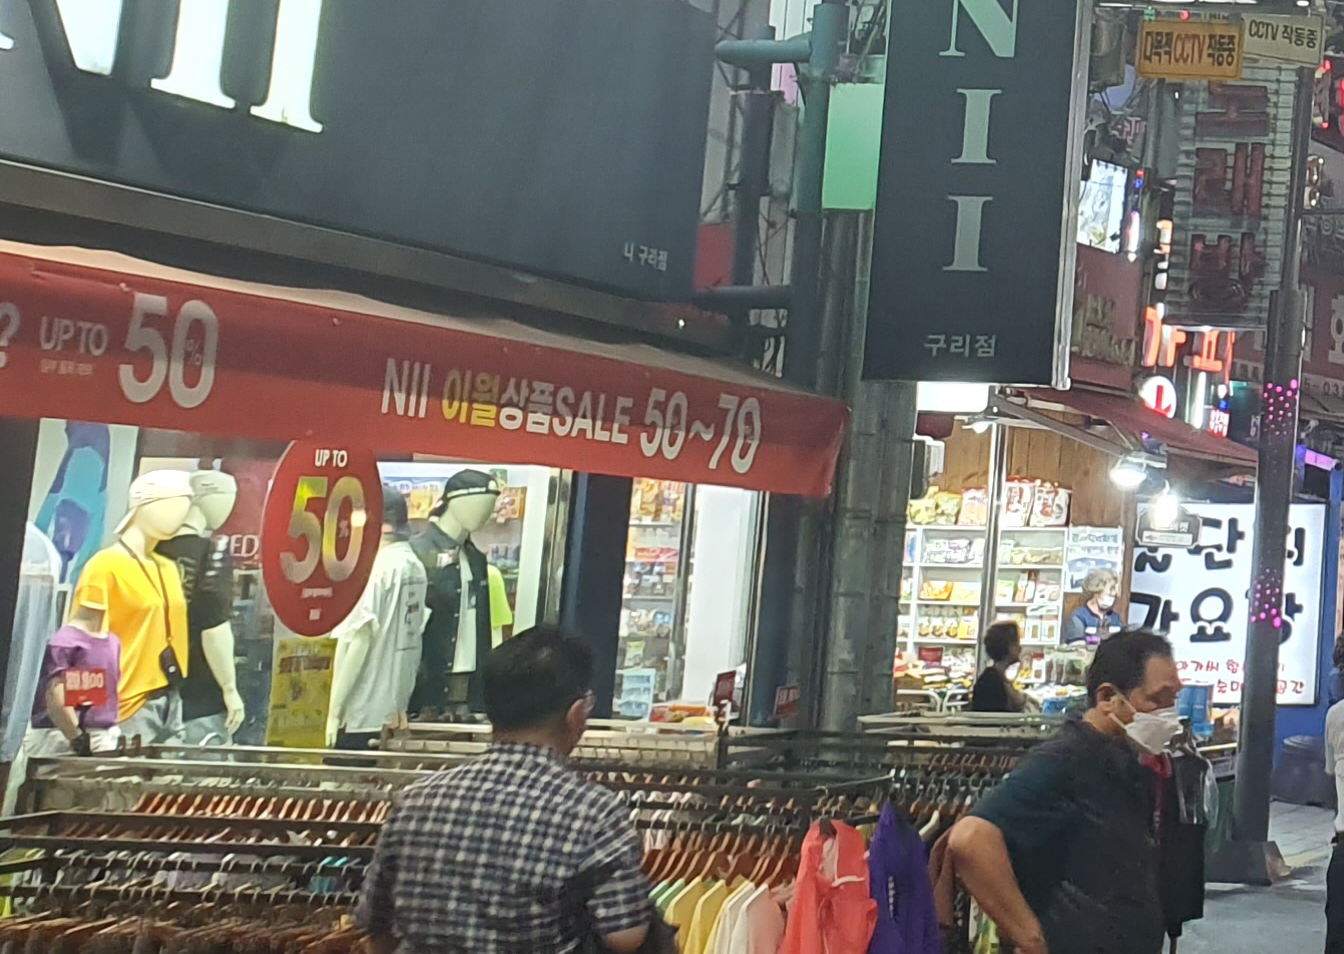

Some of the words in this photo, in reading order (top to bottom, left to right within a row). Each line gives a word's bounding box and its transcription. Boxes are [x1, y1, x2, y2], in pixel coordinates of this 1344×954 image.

[1174, 32, 1205, 64] CCTV
[1249, 19, 1279, 41] CCTV
[1282, 24, 1318, 48] 작동중
[39, 316, 75, 351] UP
[78, 321, 109, 356] TO
[923, 334, 997, 357] 구리점
[381, 358, 431, 418] NII
[314, 449, 331, 467] UP
[332, 449, 348, 467] TO
